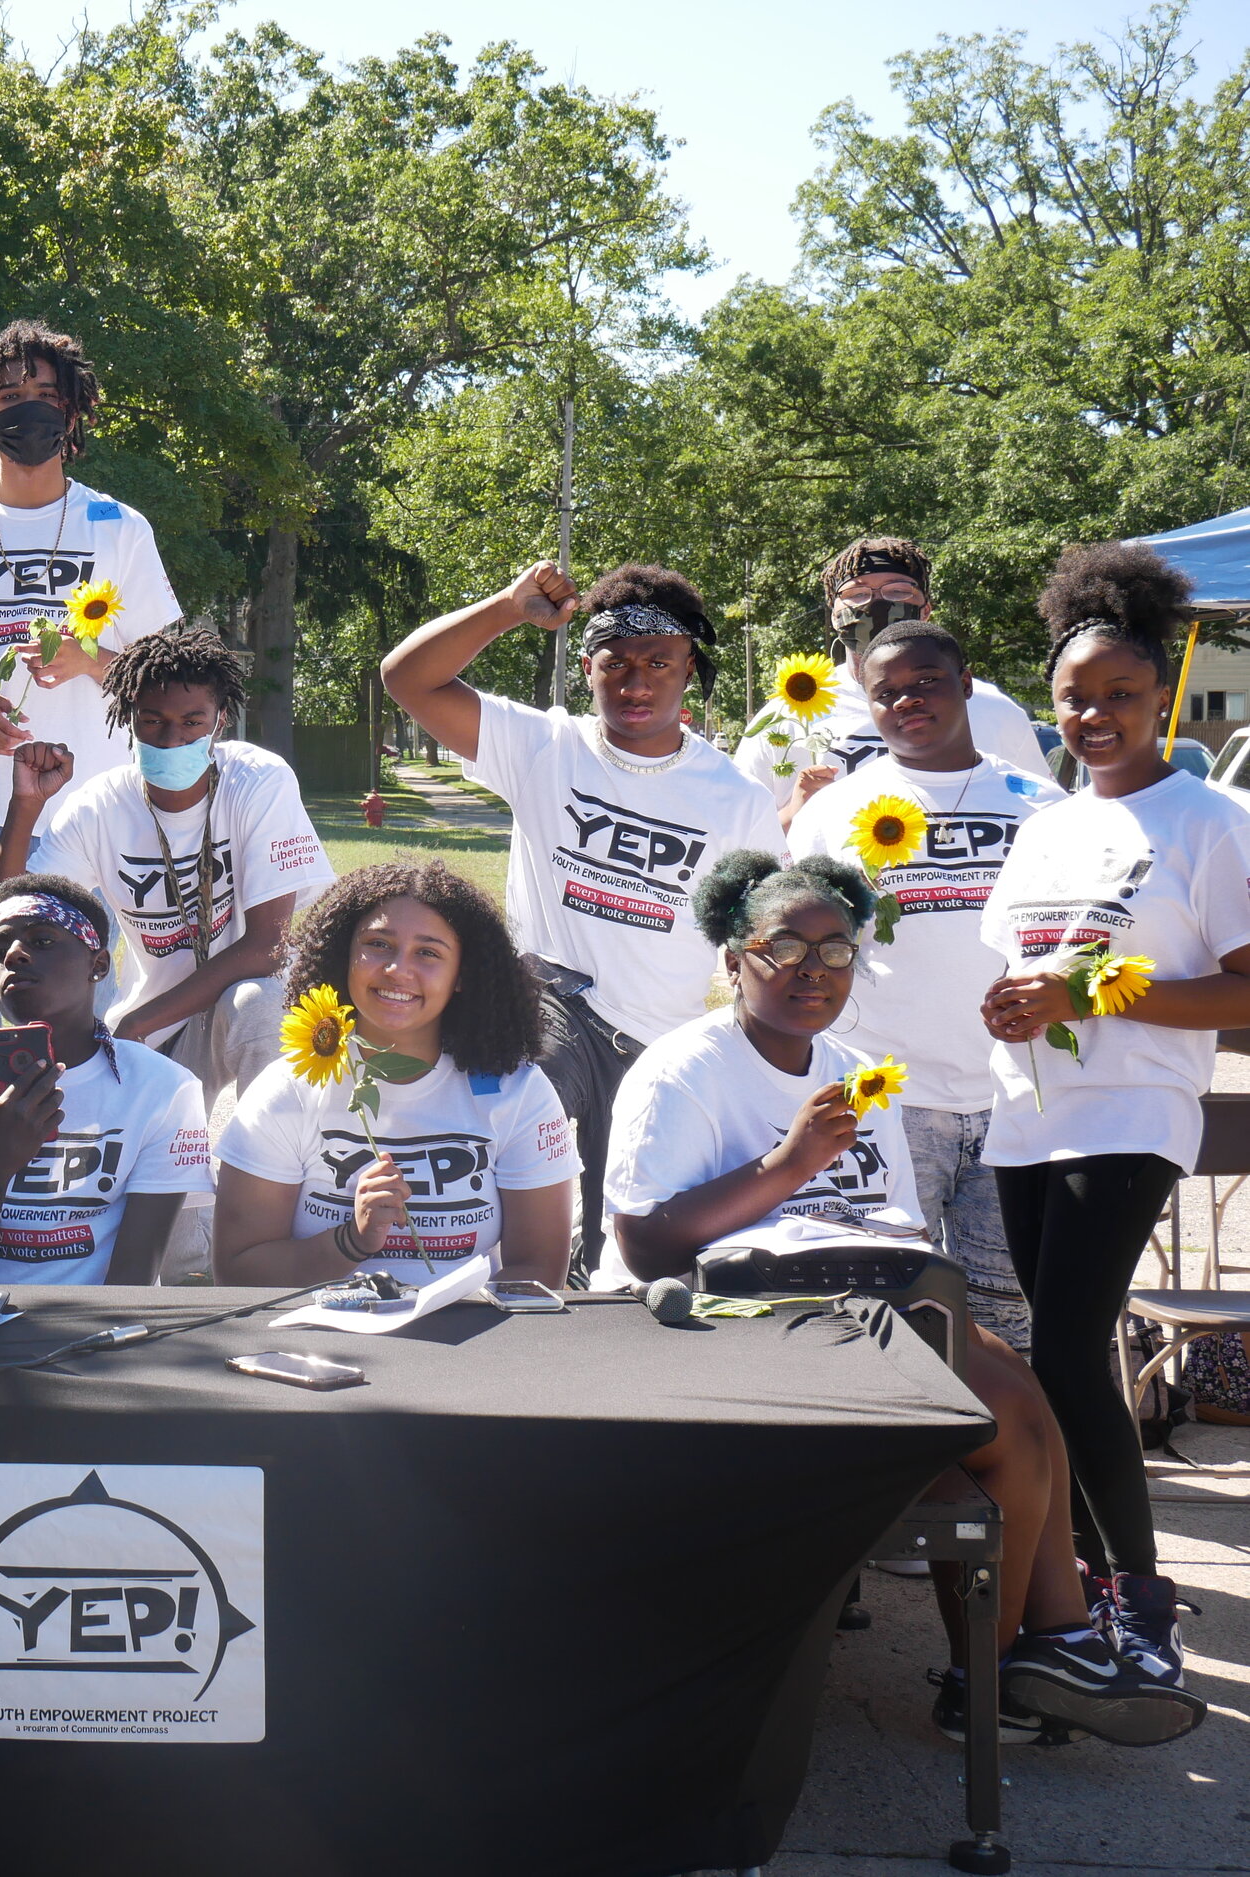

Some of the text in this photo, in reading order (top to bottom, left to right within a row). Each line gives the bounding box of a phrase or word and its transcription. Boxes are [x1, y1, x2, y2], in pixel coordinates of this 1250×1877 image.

[14, 623, 29, 631] vot
[15, 632, 31, 640] vot
[564, 804, 706, 881] YEP!
[925, 820, 1019, 860] EP!
[552, 853, 580, 874] YOUTH
[582, 868, 651, 894] EMPOWERMEN
[880, 874, 903, 886] OUTH
[906, 871, 980, 882] EMPOWERMENT
[900, 887, 992, 900] every vote matte
[569, 884, 674, 917] every vote matters.
[904, 898, 986, 911] every vote coun
[568, 896, 667, 928] every vote counts.
[1087, 911, 1135, 930] PROJECT
[144, 936, 171, 946] every
[1020, 931, 1044, 941] very
[1047, 931, 1064, 940] vot
[148, 944, 175, 955] every
[175, 1127, 209, 1140] Freed
[169, 1141, 209, 1154] Liberat
[175, 1154, 211, 1166] Justic
[11, 1141, 123, 1193] EP!
[1, 1208, 66, 1221] OWERMENT
[304, 1200, 340, 1221] YOUTH
[450, 1206, 495, 1227] PROJECT
[8, 1232, 34, 1242] vote
[37, 1228, 90, 1243] matters.
[386, 1235, 474, 1248] ote matters.
[11, 1247, 37, 1258] vote
[40, 1243, 89, 1257] counts.
[381, 1250, 413, 1259] vote
[30, 1708, 148, 1722] EMPOWERMENT
[153, 1710, 219, 1722] PROJECT
[23, 1725, 59, 1734] program
[71, 1725, 119, 1734] Community
